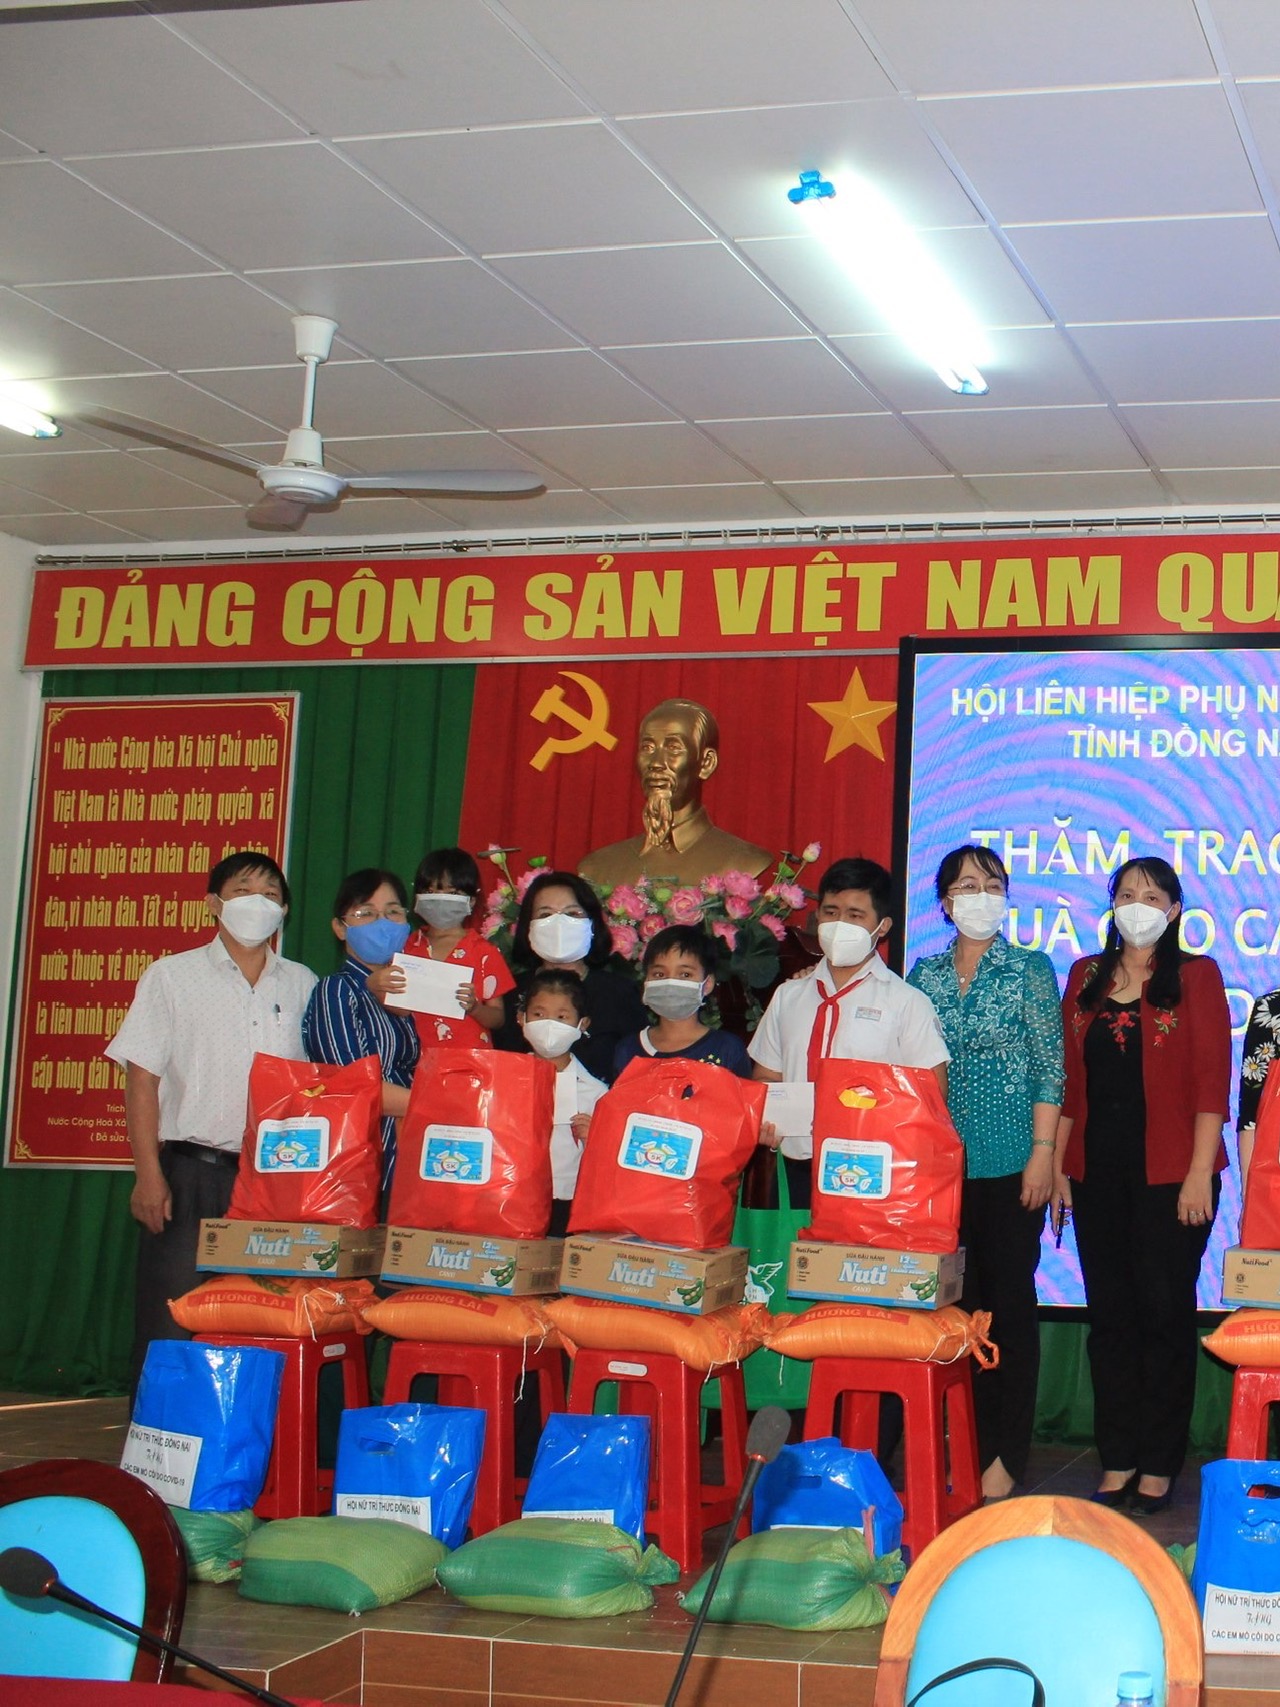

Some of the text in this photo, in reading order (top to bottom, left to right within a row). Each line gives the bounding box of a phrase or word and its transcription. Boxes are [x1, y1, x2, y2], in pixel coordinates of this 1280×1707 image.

[54, 569, 255, 649] ĐẢNG
[282, 567, 495, 657] CỘNG
[523, 554, 683, 640] SẢN
[713, 551, 897, 646] VIỆT
[927, 555, 1121, 629] NAM
[951, 682, 1005, 722] HỘI
[1016, 680, 1086, 715] LIÊN
[1096, 681, 1169, 720] HIỆP
[1179, 685, 1247, 720] PHỤ
[89, 736, 117, 769] nước
[120, 736, 150, 775] Cộng
[153, 735, 174, 767] hòa
[177, 734, 193, 767] Xã
[196, 734, 216, 773] hội
[219, 730, 241, 767] Chủ
[244, 733, 278, 772] nghĩa
[1068, 721, 1140, 758] TỈNH
[1150, 722, 1246, 759] ĐỒNG
[53, 785, 275, 827] Việt Nam là Nhà nước pháp quyền xã
[48, 842, 67, 882] hội
[69, 838, 91, 874] chủ
[94, 842, 127, 879] nghĩa
[130, 837, 151, 873] của
[154, 841, 184, 873] nhân
[83, 891, 178, 927] nhân dân. Tất cả
[40, 948, 122, 987] nước thuộc về
[36, 1001, 103, 1034] là liên minh
[32, 1054, 110, 1094] cấp nông dân
[245, 1233, 293, 1257] Nuti
[427, 1245, 473, 1270] Nuti
[608, 1260, 656, 1288] Nuti
[838, 1260, 888, 1285] Nuti
